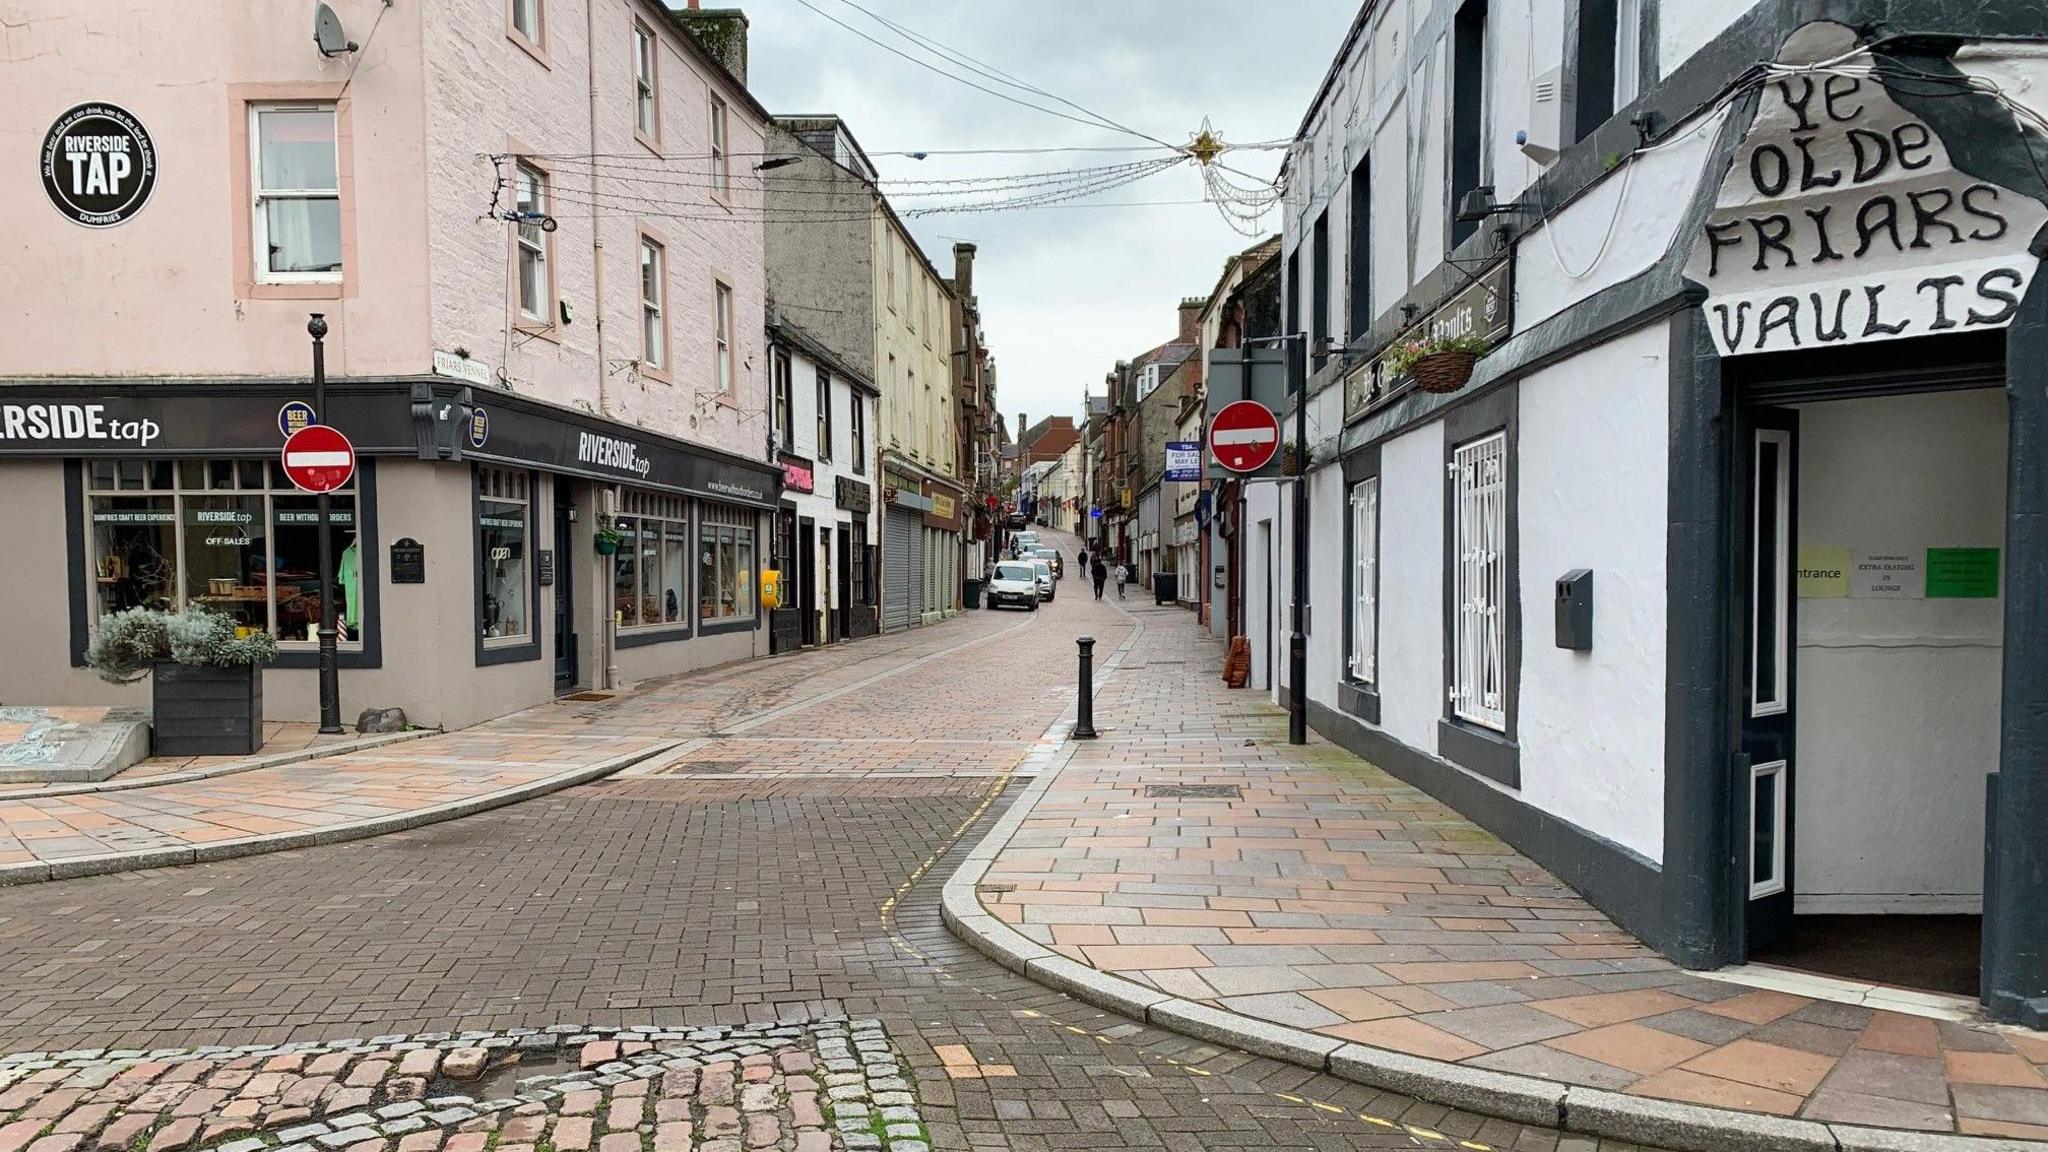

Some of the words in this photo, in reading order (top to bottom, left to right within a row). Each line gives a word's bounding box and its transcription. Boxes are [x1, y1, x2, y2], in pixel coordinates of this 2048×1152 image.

[1779, 74, 1864, 133] Ye
[55, 122, 65, 135] and
[65, 135, 130, 152] RIVERSIDE
[65, 151, 131, 195] TAP
[79, 212, 121, 224] DUMFRIES
[1705, 184, 2008, 278] FRIARS
[1713, 268, 2024, 354] VAULTS
[287, 410, 308, 421] BEER
[0, 404, 108, 439] RSIDE
[109, 418, 160, 447] tap
[579, 431, 637, 471] RIVERSIDE
[635, 457, 650, 479] tap
[118, 513, 134, 521] CRAFT
[134, 513, 147, 521] BEER
[197, 511, 236, 521] RIVERSIDE
[236, 513, 252, 524] tap
[279, 513, 295, 521] BEER
[296, 513, 319, 521] WITHOU
[223, 537, 250, 545] SALES
[1796, 568, 1841, 578] ntrance
